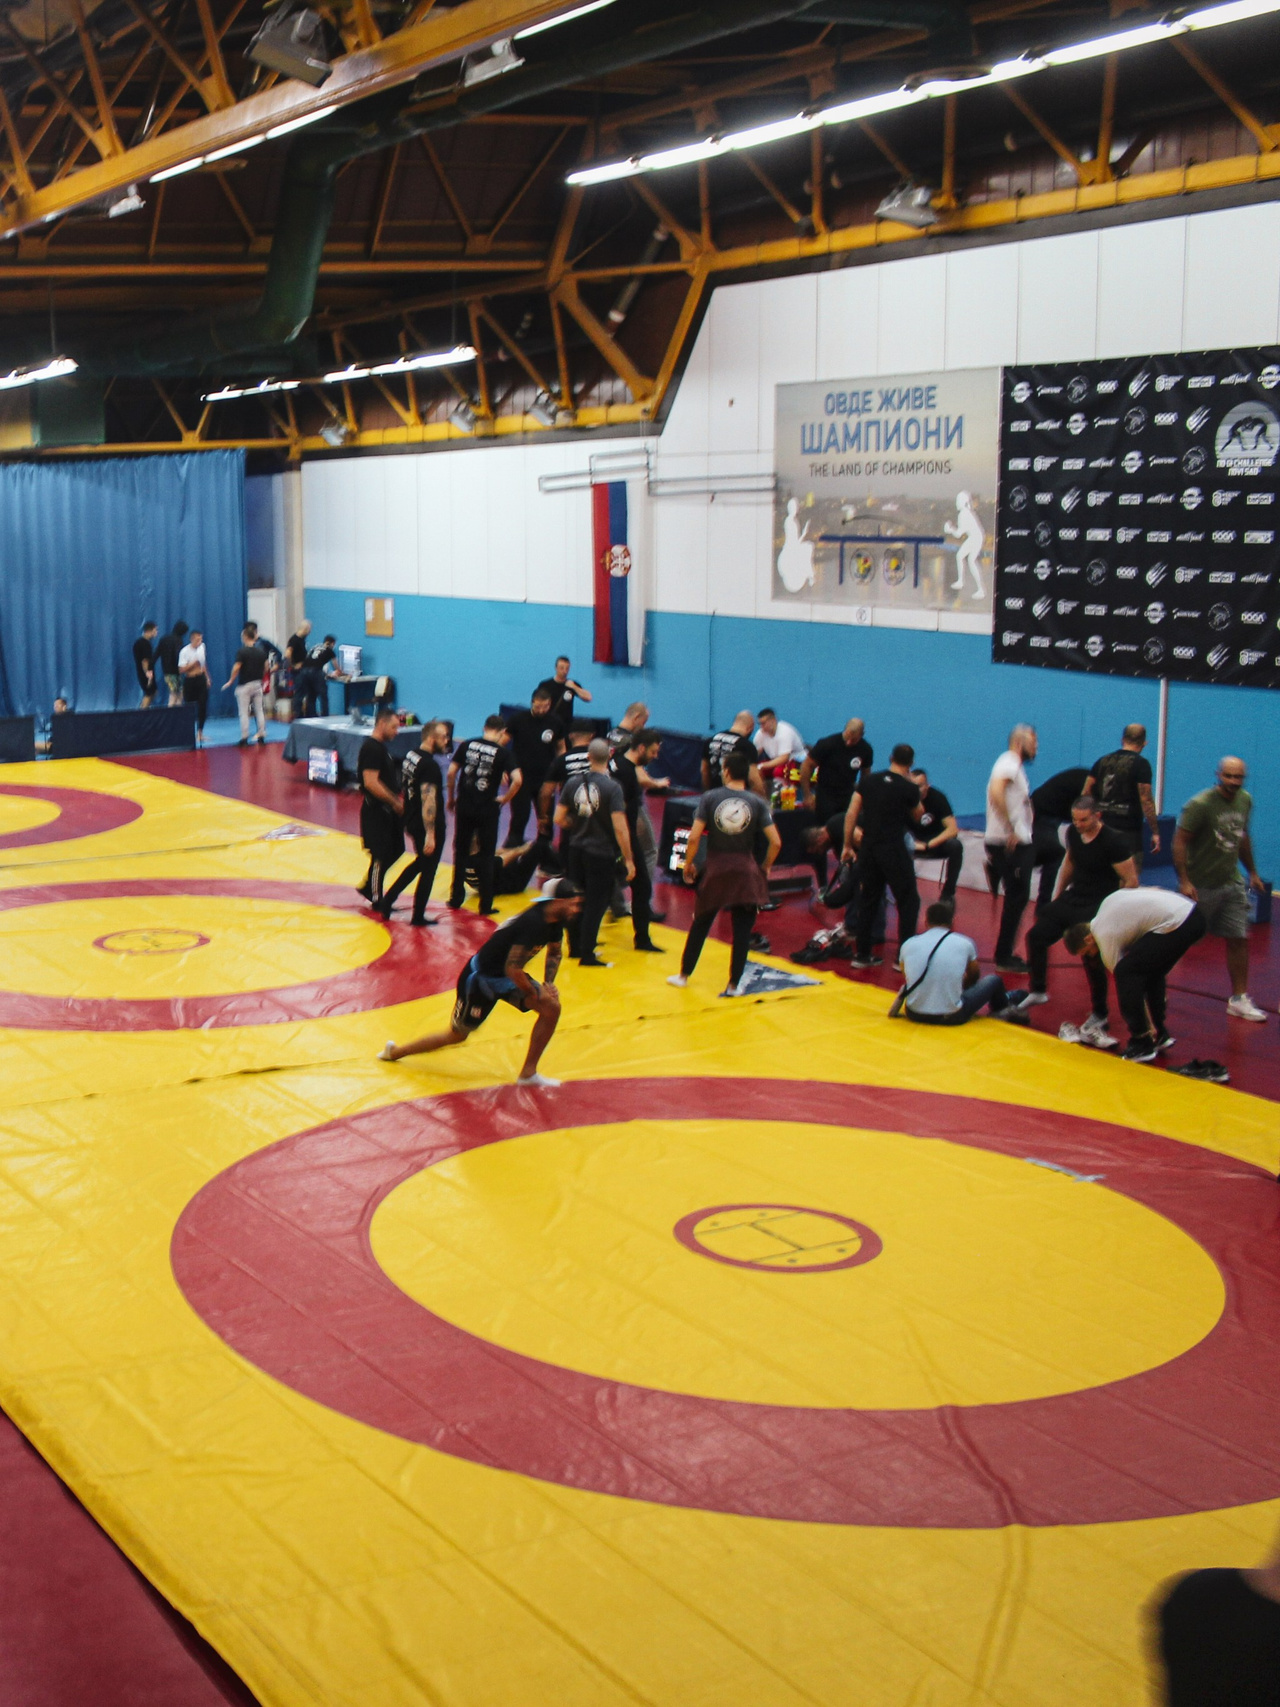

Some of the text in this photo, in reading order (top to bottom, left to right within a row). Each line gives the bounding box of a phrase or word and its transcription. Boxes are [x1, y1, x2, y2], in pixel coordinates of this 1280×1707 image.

[824, 385, 938, 418] ОВДЕ ЖИВЕ
[800, 414, 965, 455] ШАМПИОНИ
[809, 459, 952, 478] THE LAND OF CHAMPIONS
